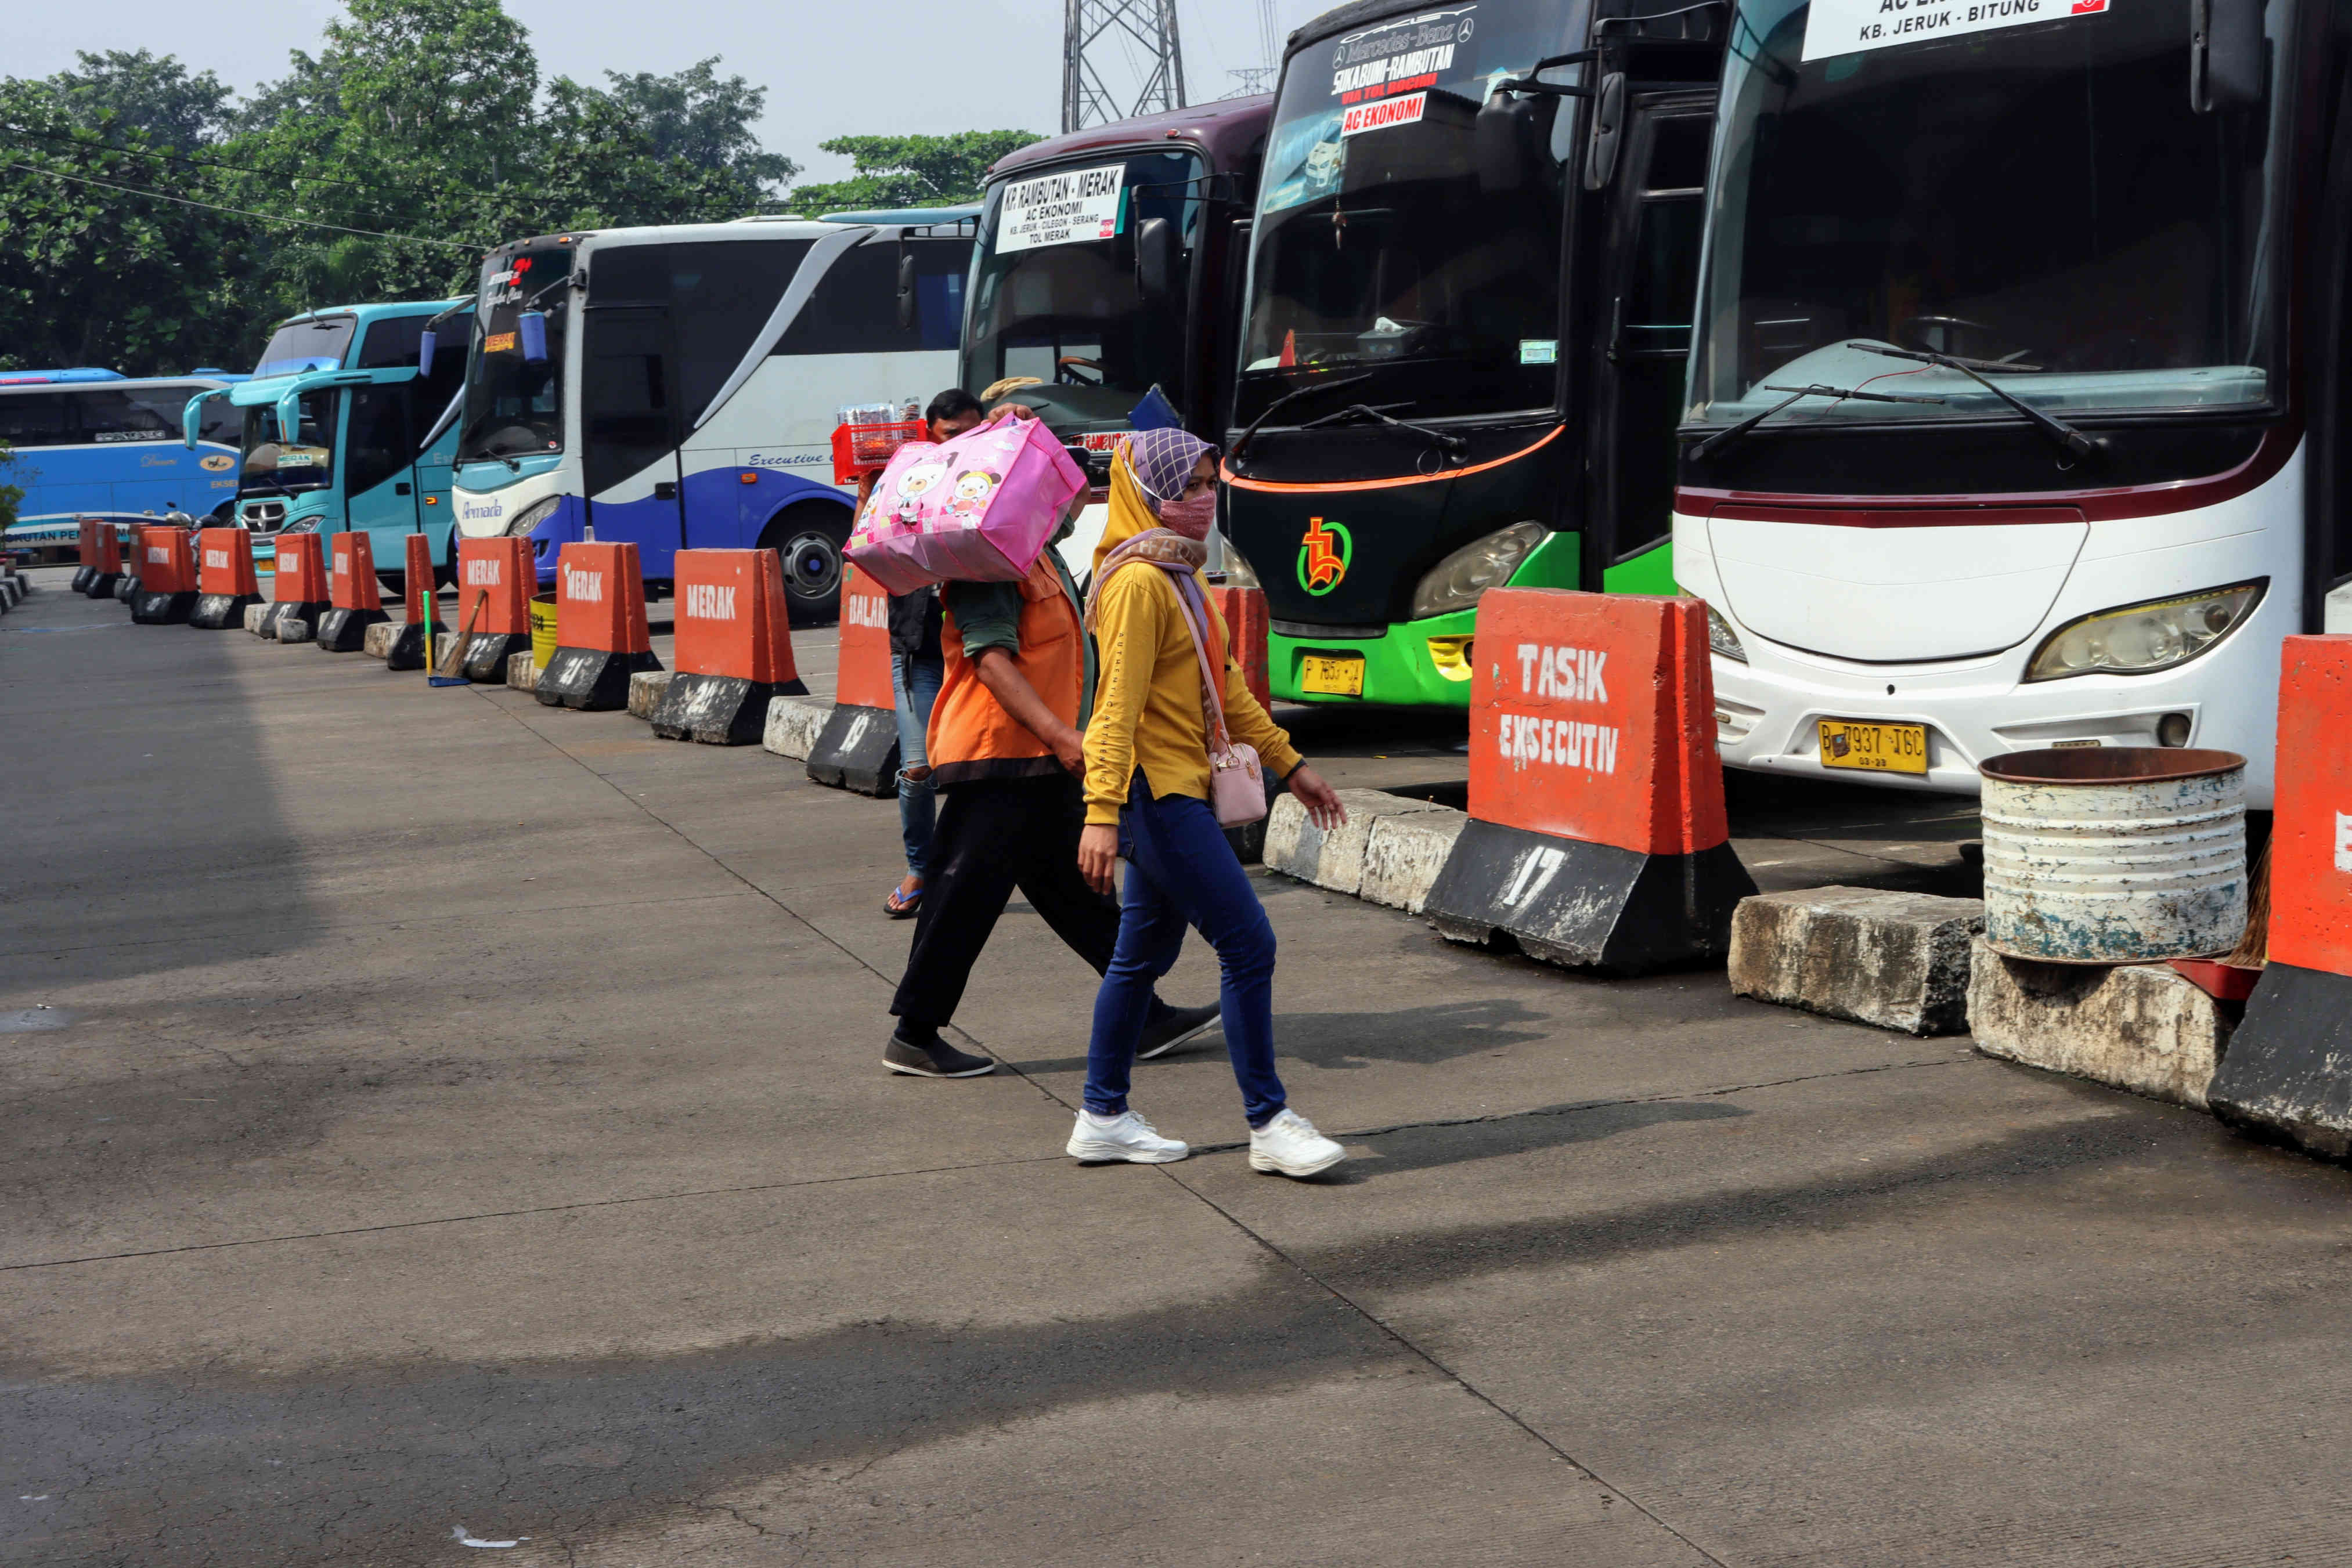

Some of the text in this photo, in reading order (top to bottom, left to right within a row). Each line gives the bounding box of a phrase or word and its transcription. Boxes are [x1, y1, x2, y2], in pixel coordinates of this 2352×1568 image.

[1859, 23, 1886, 41] KB.
[1893, 11, 1951, 35] JERUK
[1968, 1, 2039, 22] BITUNG
[1345, 23, 1456, 64] Mercedes-Benz
[1331, 44, 1455, 96] SUKABUMI-RAMBUTAN
[1341, 89, 1362, 105] VIA
[1364, 84, 1385, 100] TOL
[1344, 96, 1423, 132] AC EKONOMI
[1004, 187, 1018, 212] KP.
[1018, 176, 1071, 208] RAMBUTAN
[1077, 169, 1119, 198] MERAK
[1019, 222, 1037, 234] JERUK
[1041, 218, 1067, 230] CILEGON
[1073, 214, 1099, 226] SERANG
[1025, 201, 1083, 222] AC EKONOMI
[1030, 229, 1071, 244] TOL MERAK
[748, 454, 824, 465] Executive
[467, 559, 500, 586] MERAK
[566, 570, 603, 602] MERAK
[686, 584, 736, 620] MERAK
[1106, 631, 1124, 707] AUTHENTIC
[1517, 643, 1608, 704] TASIK
[1821, 724, 1831, 750] B
[1843, 725, 1881, 754] 7937
